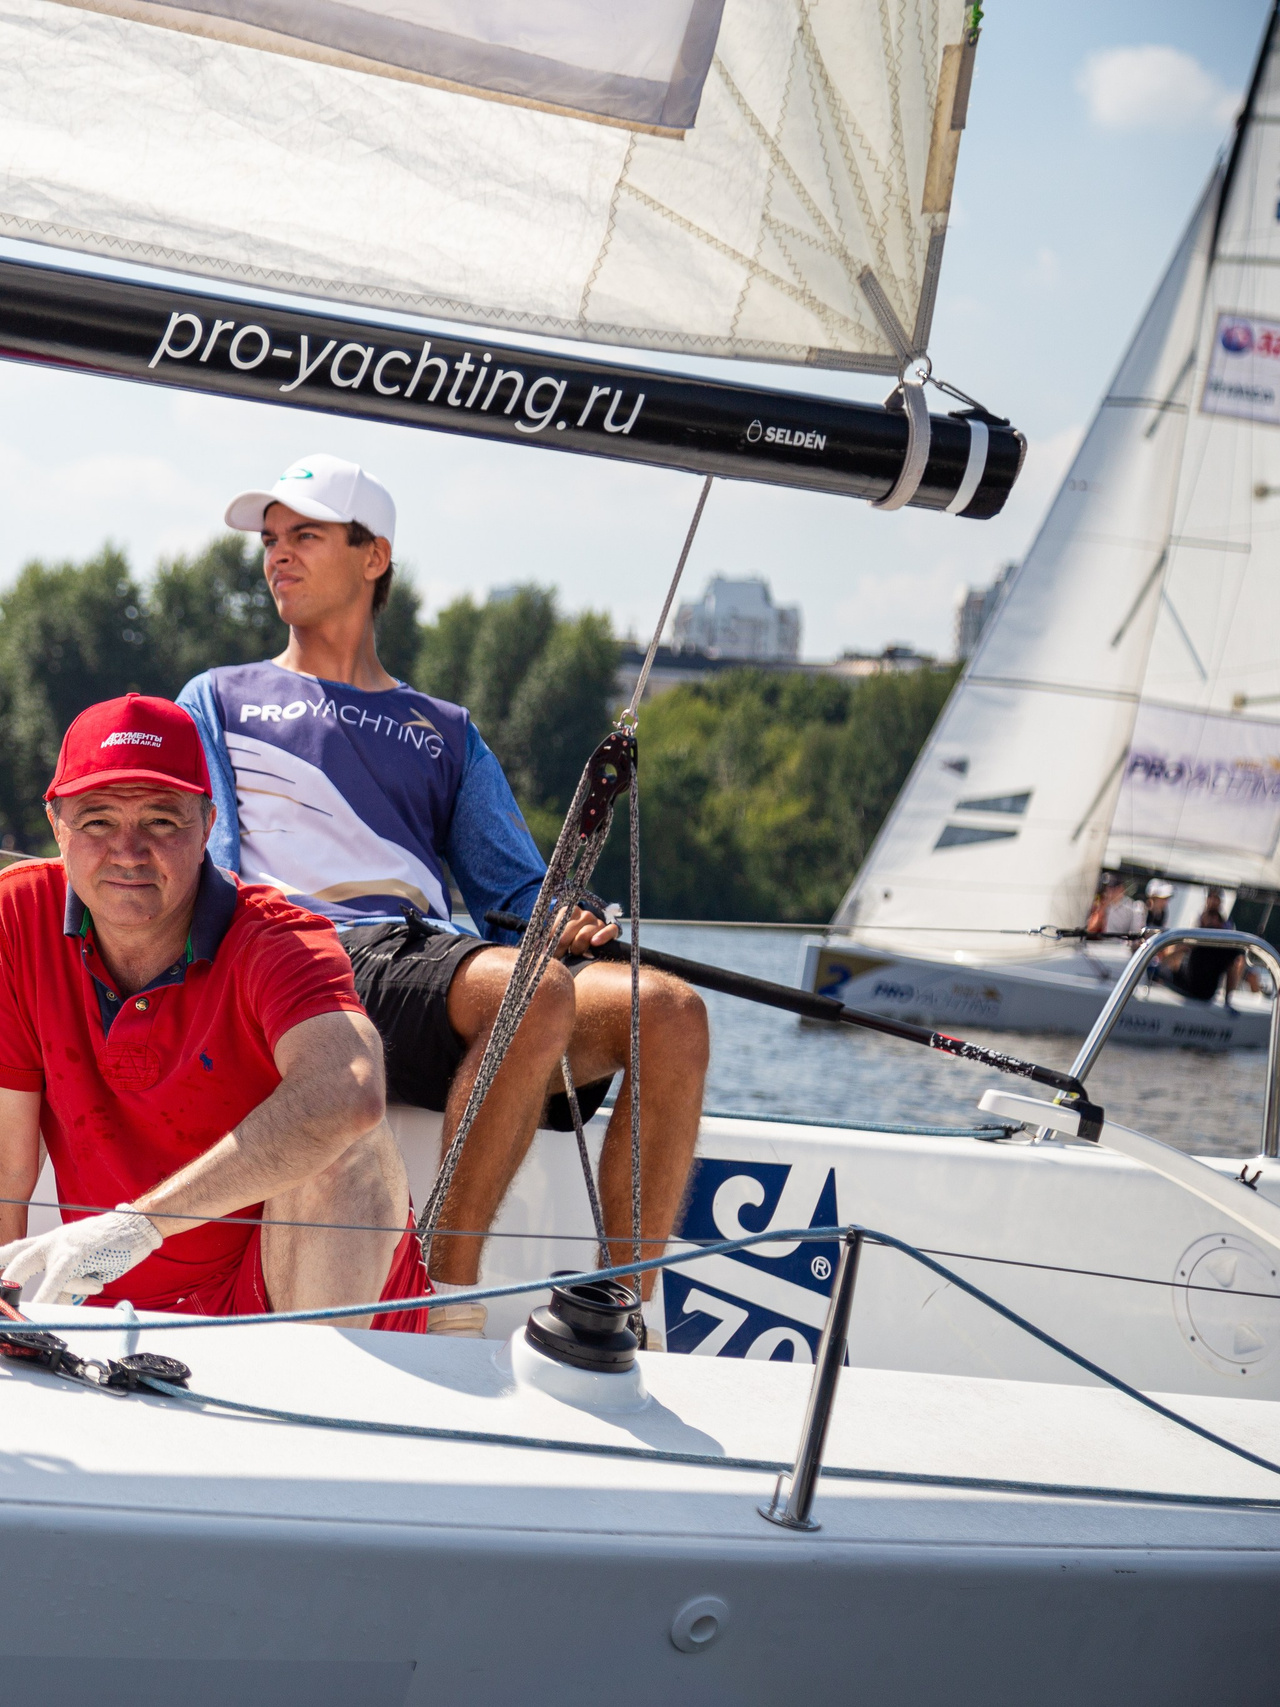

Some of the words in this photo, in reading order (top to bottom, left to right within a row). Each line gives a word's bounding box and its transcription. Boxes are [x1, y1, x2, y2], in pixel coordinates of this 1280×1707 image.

[148, 312, 646, 434] pro-yachting.ru
[764, 426, 827, 451] SELDÉN
[102, 732, 163, 743] АРГУМЕНТЫ
[240, 697, 445, 760] PROYACHTING
[140, 740, 161, 748] AIF.RU
[818, 963, 852, 998] 2
